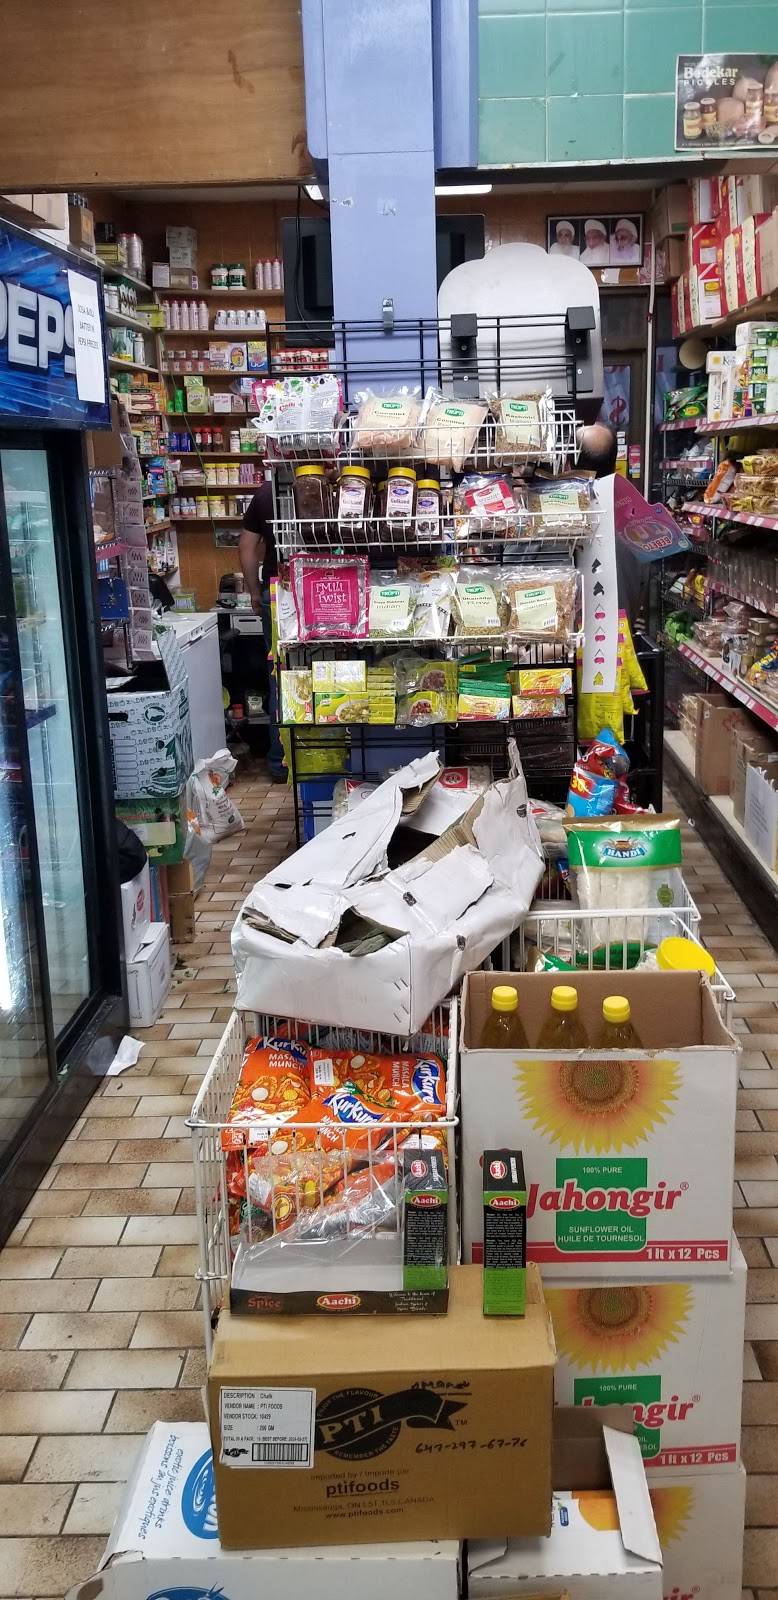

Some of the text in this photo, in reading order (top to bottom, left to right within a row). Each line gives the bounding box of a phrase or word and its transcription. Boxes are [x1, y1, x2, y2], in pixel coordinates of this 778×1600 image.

[0, 279, 76, 374] EP
[608, 850, 641, 858] HANDI
[392, 1061, 400, 1087] MUNCH
[414, 1060, 440, 1104] Kurkure
[582, 1166, 623, 1174] 100% PURE
[414, 1197, 439, 1205] Aachi
[491, 1199, 517, 1207] Aachi
[569, 1225, 634, 1233] SUNFLOWER OIL
[596, 1234, 645, 1243] TOURNESOL
[679, 1249, 691, 1260] 12
[696, 1248, 720, 1260] Pcs
[321, 1296, 356, 1306] Aachi
[618, 1383, 637, 1391] PURE
[319, 1405, 384, 1443] PTI
[690, 1453, 702, 1464] 12
[708, 1451, 729, 1462] Pcs
[326, 1478, 400, 1498] ptifoods
[137, 1496, 157, 1540] exotiques
